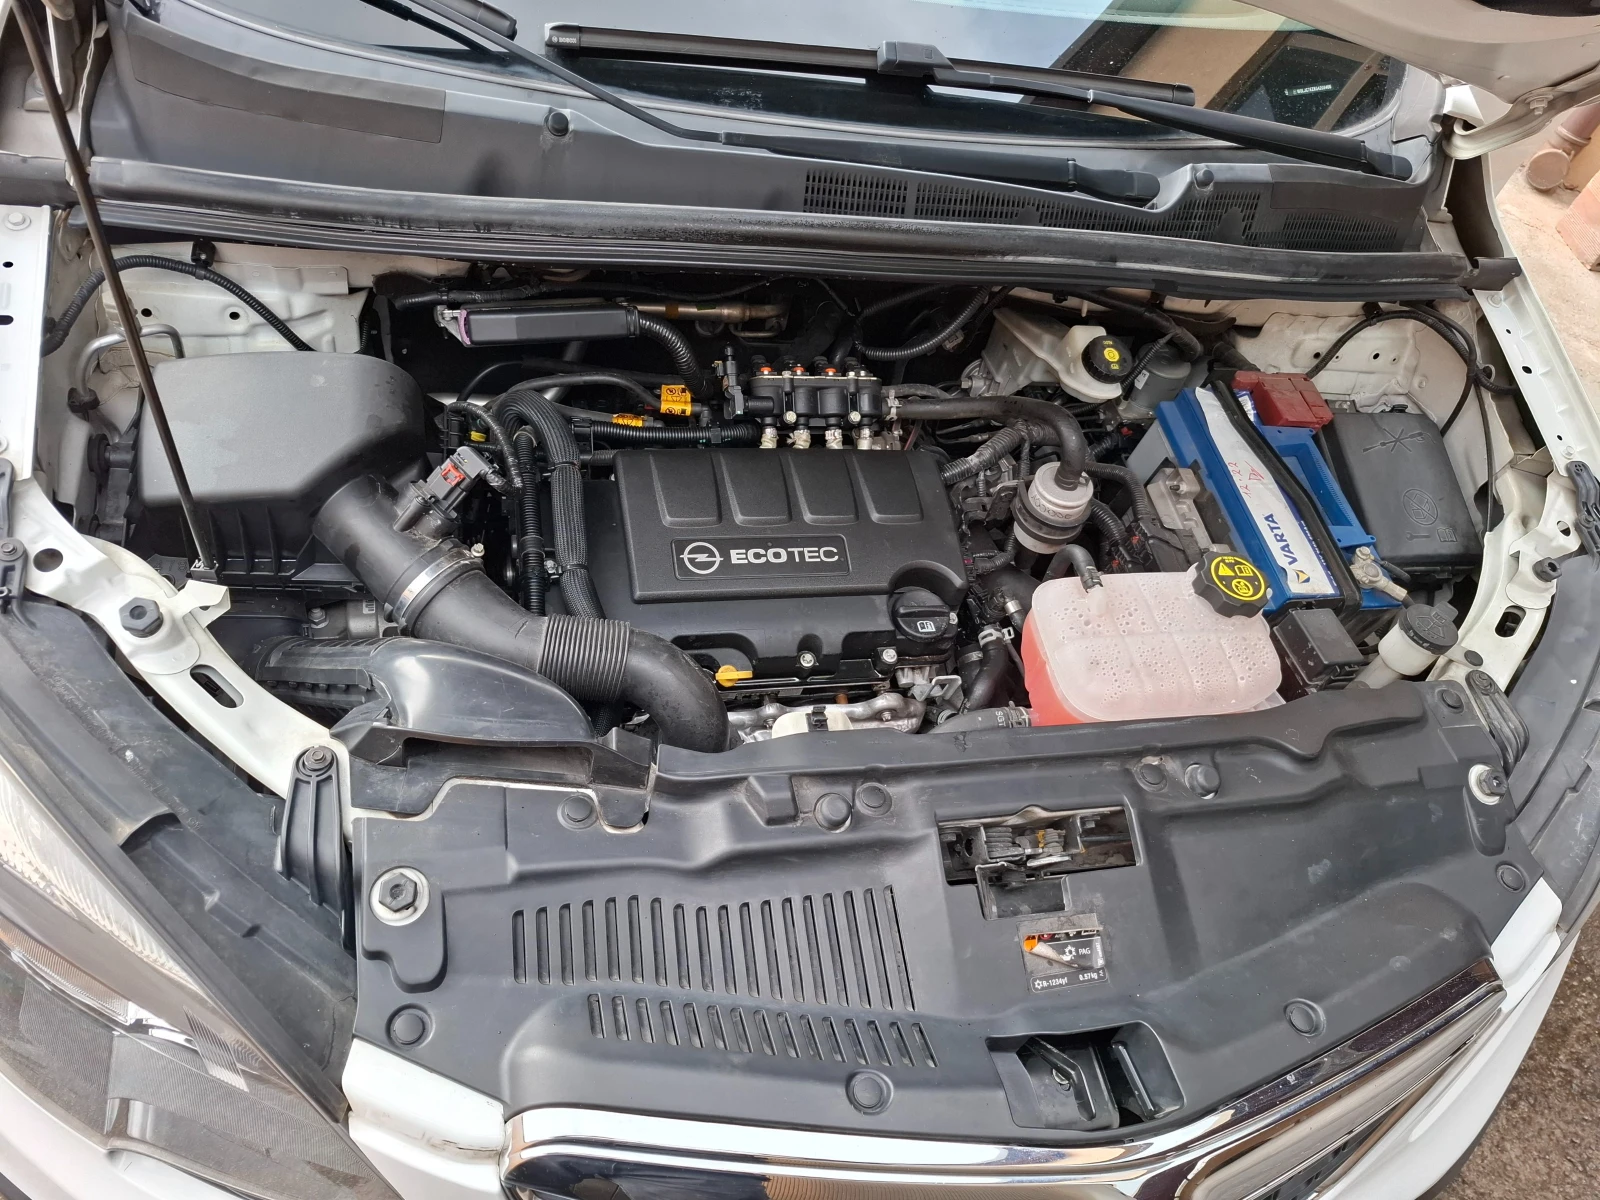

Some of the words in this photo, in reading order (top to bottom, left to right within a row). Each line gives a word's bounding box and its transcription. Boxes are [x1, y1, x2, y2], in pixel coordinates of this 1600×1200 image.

[1265, 513, 1298, 564] VARTA
[729, 546, 839, 564] ECOTEC
[1042, 977, 1068, 988] R-1234yf
